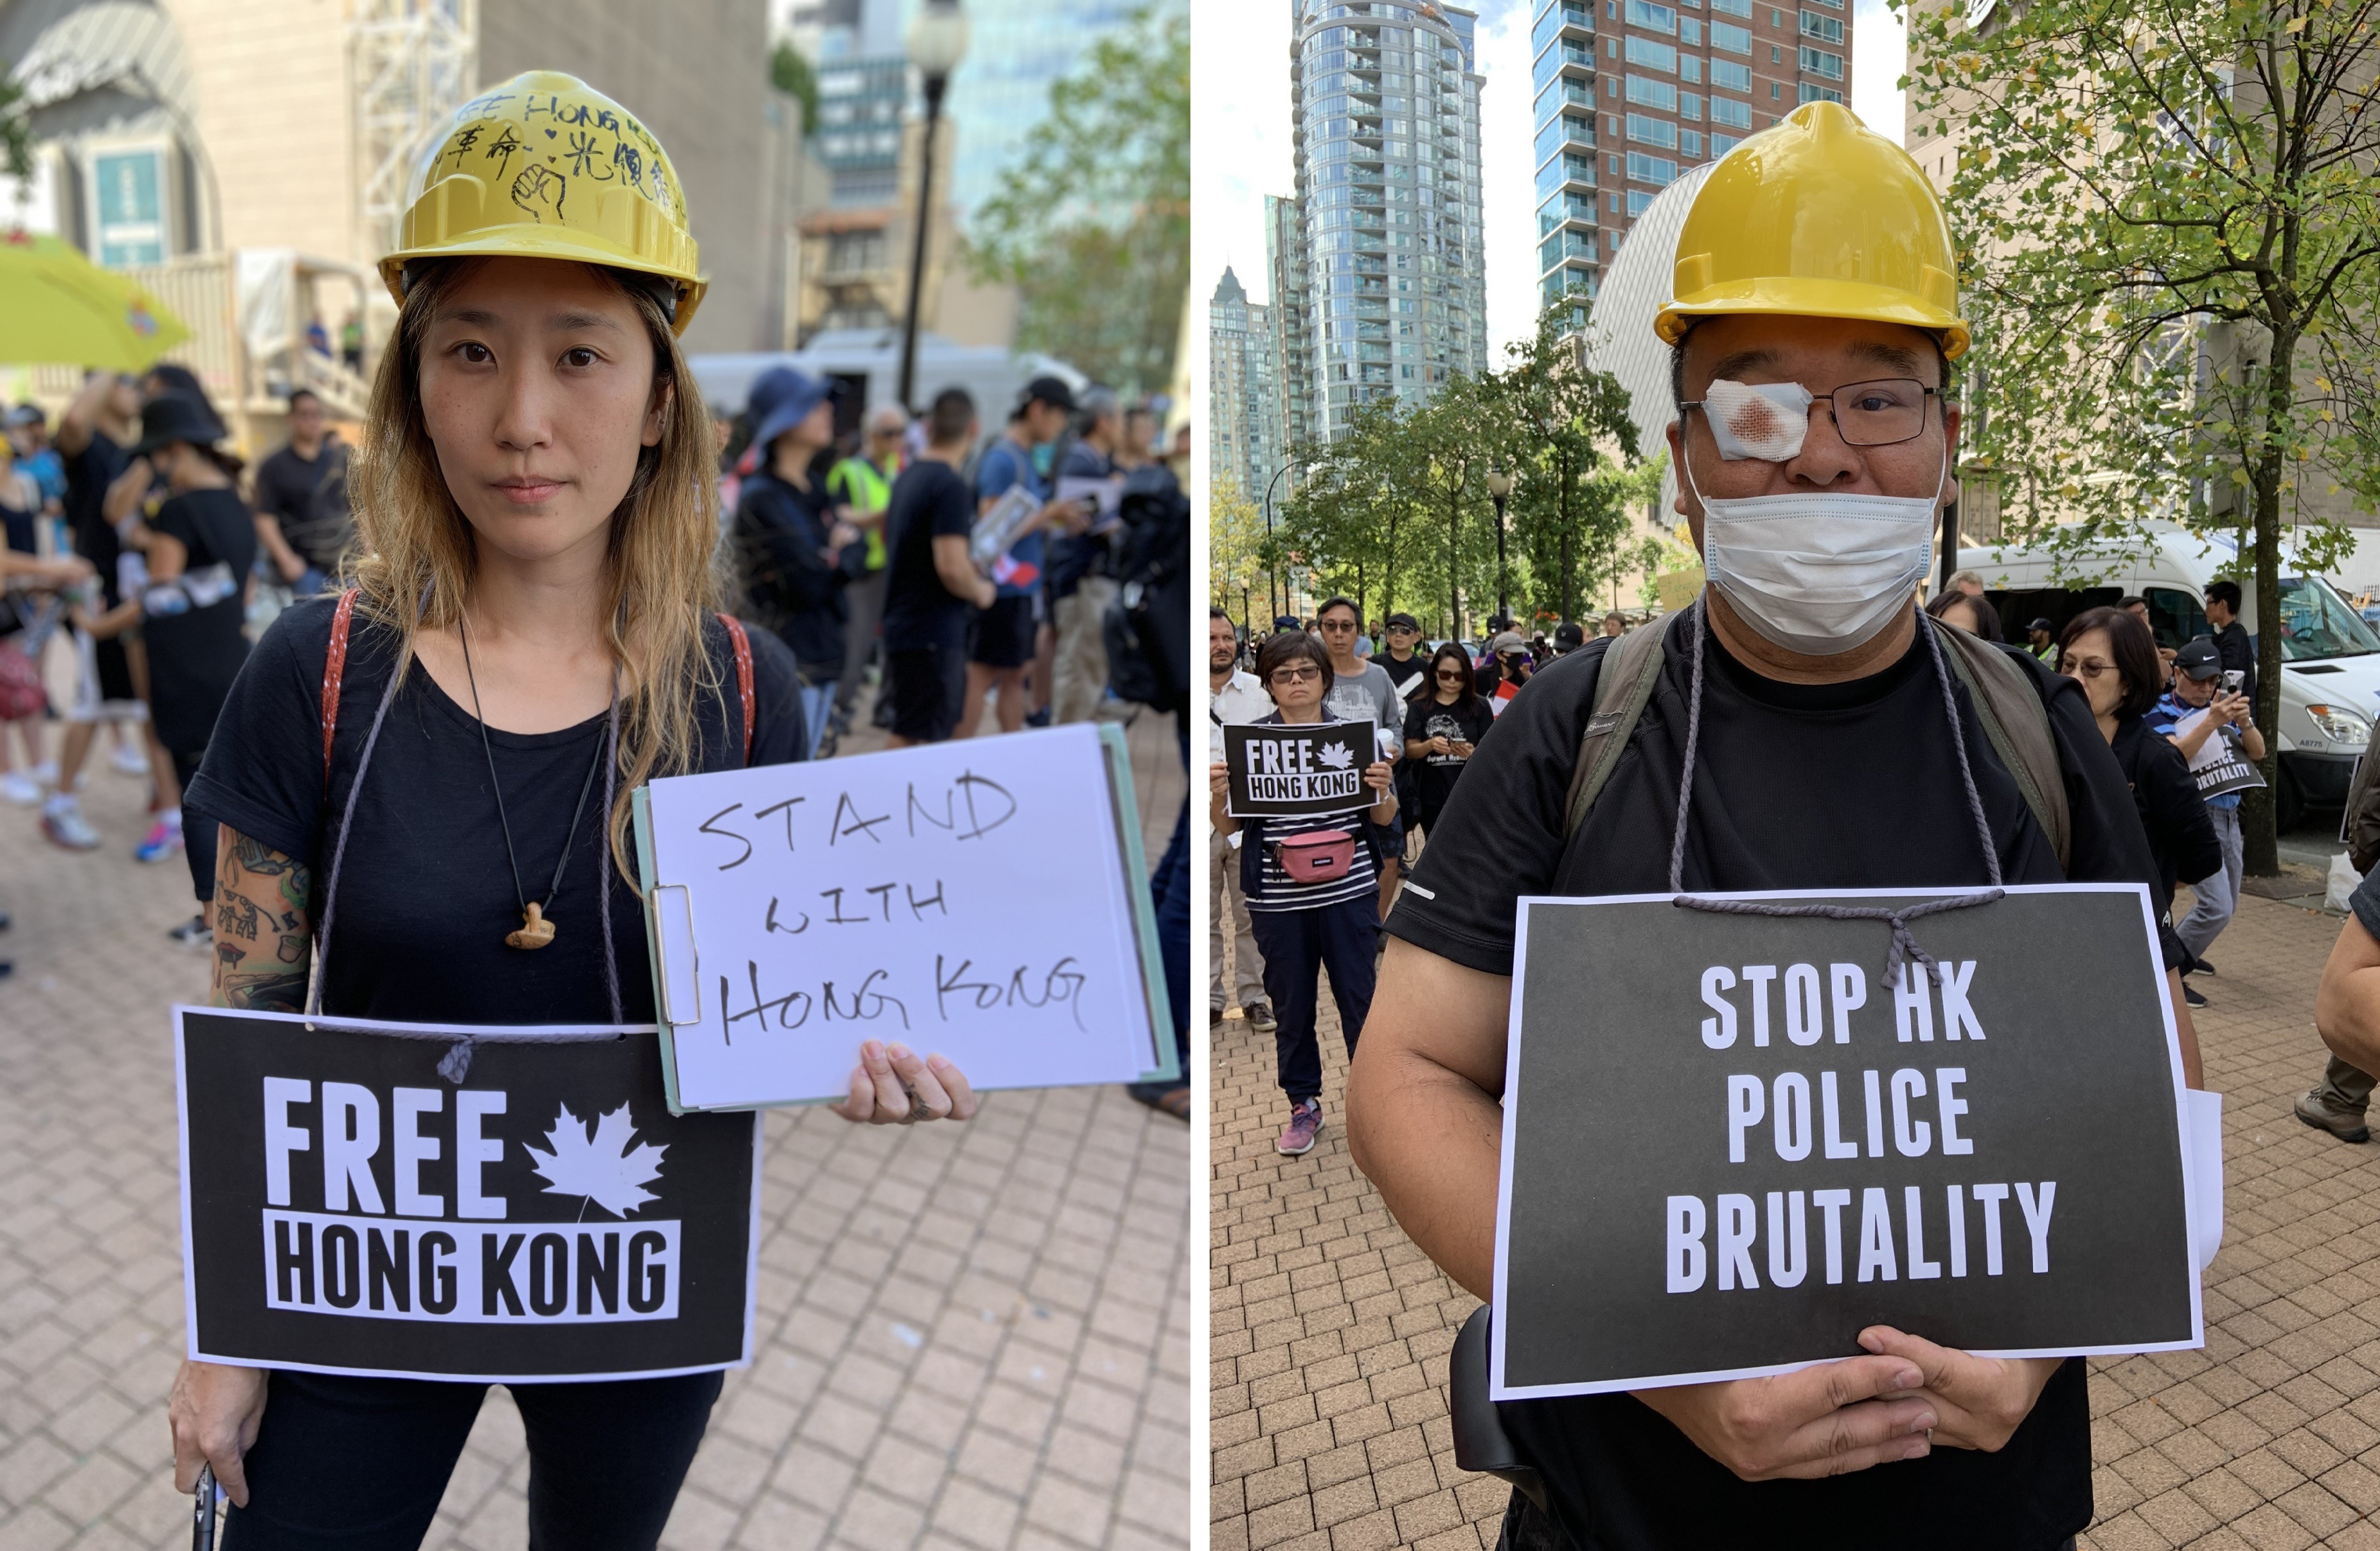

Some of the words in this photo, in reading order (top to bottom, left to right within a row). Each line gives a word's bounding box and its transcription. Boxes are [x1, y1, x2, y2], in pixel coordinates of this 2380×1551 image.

[524, 95, 622, 141] HONG
[1246, 739, 1314, 774] FREE
[1251, 776, 1302, 799] HONG
[1307, 773, 1356, 799] KONG
[699, 769, 1017, 871] STAND
[766, 879, 946, 934] WITH
[720, 960, 909, 1046] HONG
[936, 954, 1088, 1034] KONG
[1701, 963, 1867, 1050] STOP
[1893, 960, 1986, 1042] HK
[263, 1076, 507, 1219] FREE
[1728, 1067, 1973, 1163] POLICE
[274, 1220, 457, 1315] HONG
[482, 1230, 666, 1316] KONG
[1667, 1182, 2056, 1293] BRUTALITY
